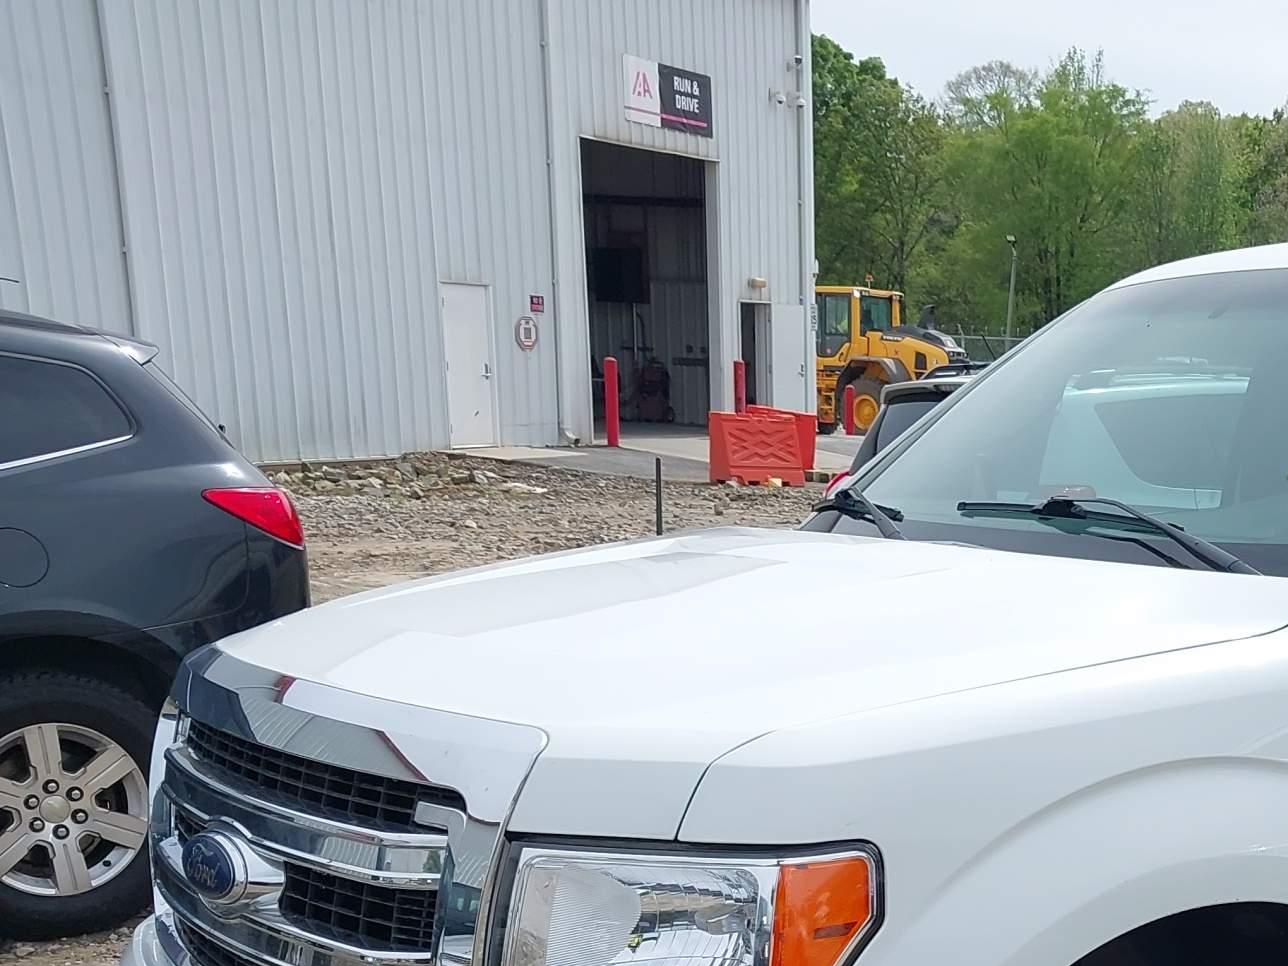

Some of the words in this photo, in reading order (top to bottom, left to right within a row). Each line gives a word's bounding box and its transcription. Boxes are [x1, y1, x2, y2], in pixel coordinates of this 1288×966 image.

[673, 76, 691, 94] RUN
[692, 81, 700, 96] &
[675, 94, 700, 113] DRIVE
[187, 843, 220, 889] Ford
